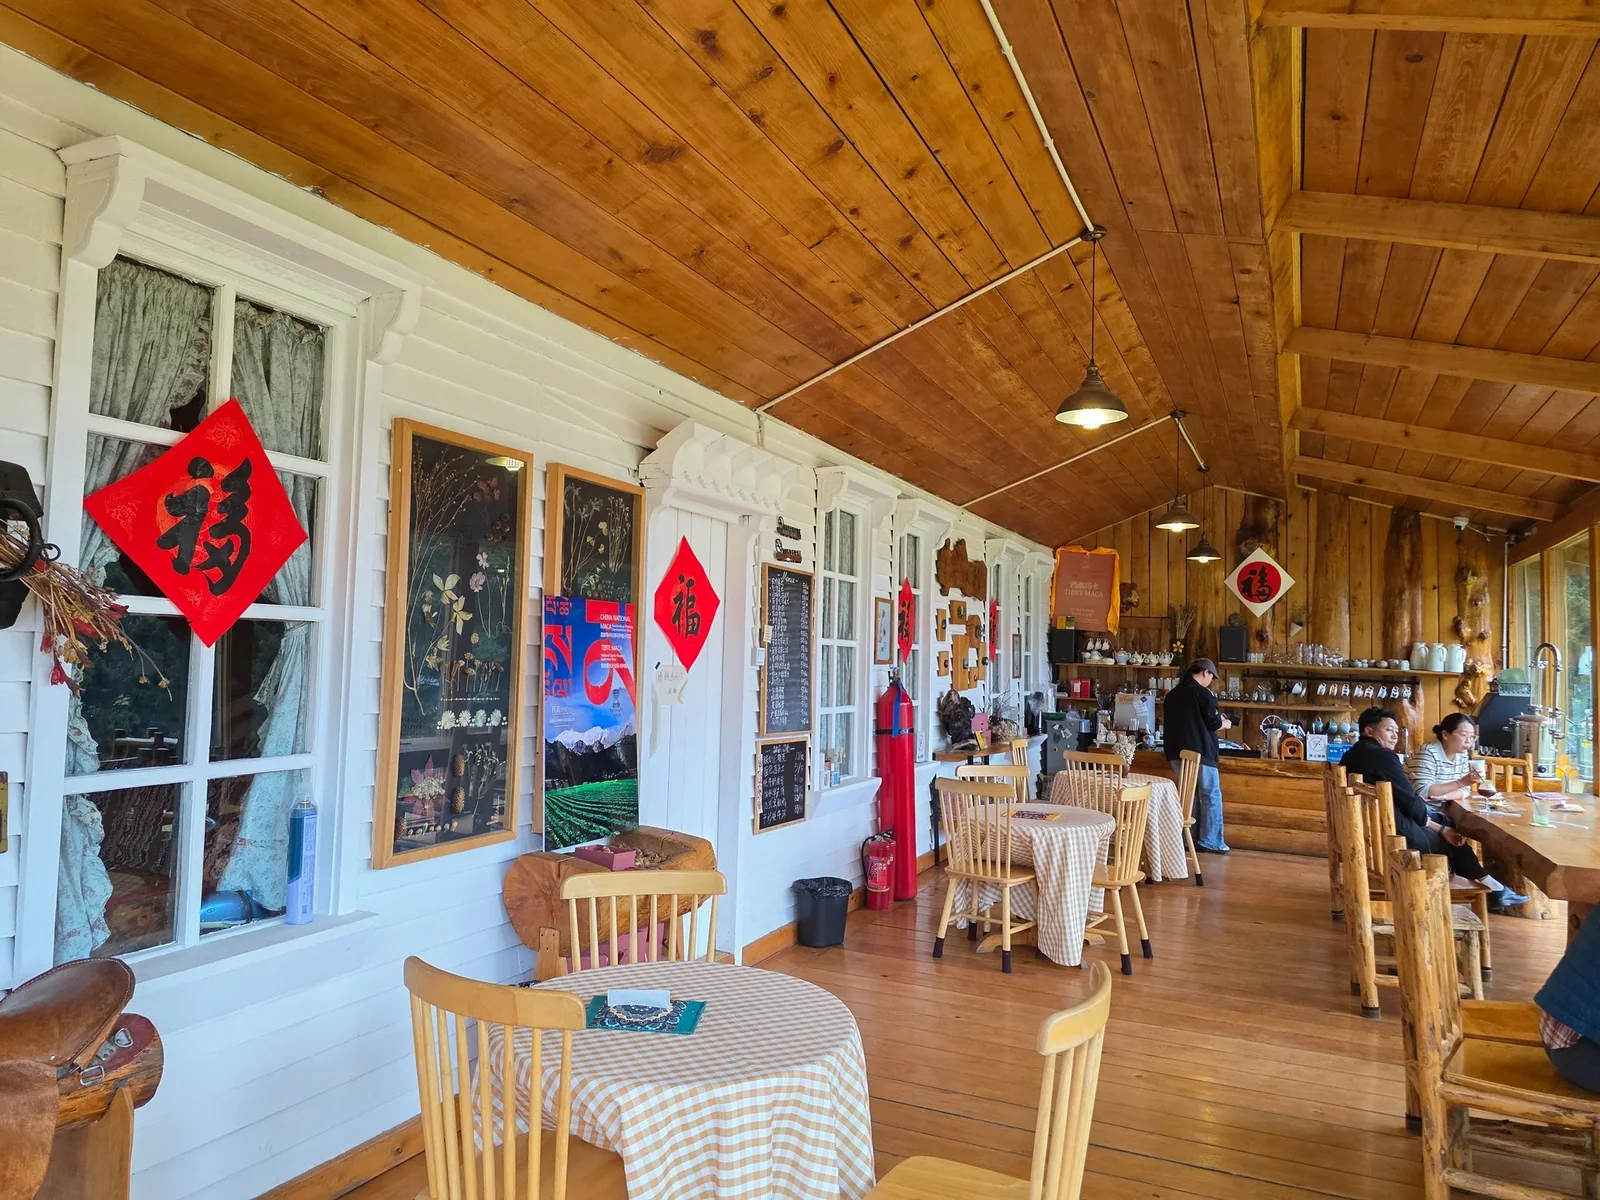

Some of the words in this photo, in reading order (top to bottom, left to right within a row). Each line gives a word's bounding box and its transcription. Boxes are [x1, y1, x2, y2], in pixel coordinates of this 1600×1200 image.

[156, 456, 252, 596] 福
[672, 574, 701, 639] 福
[1064, 588, 1083, 596] TIBET
[1084, 590, 1103, 598] MACA
[1241, 565, 1272, 602] 福
